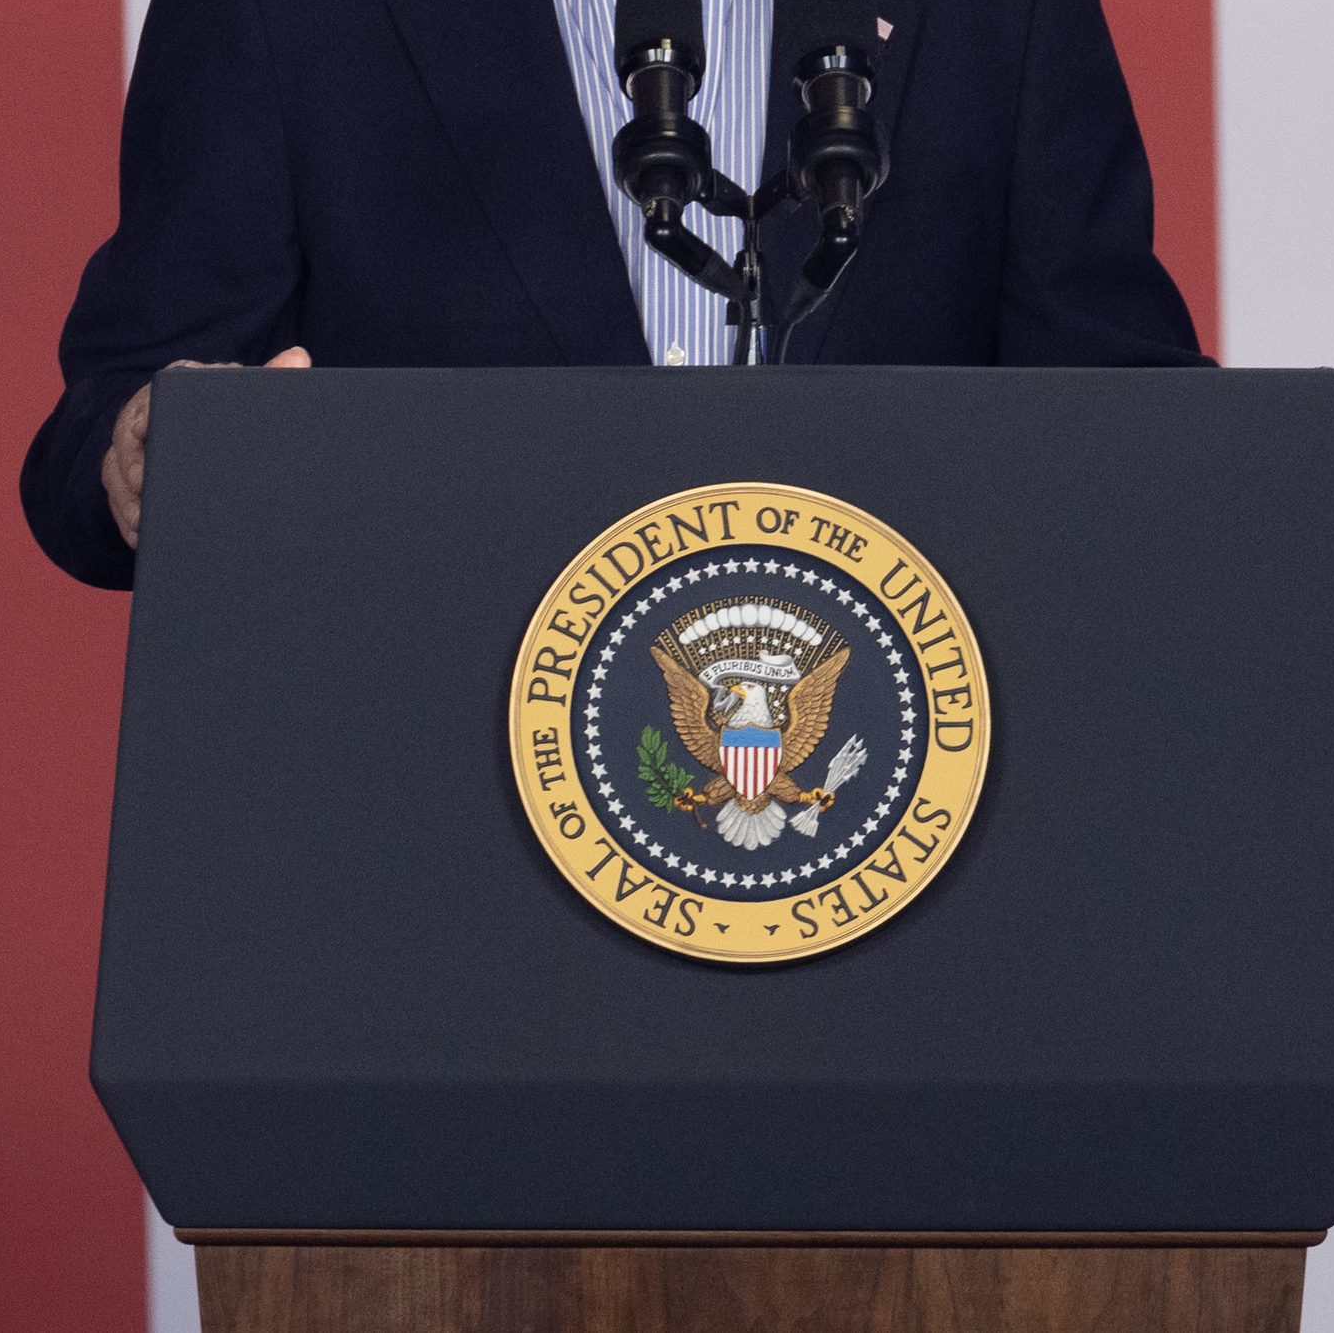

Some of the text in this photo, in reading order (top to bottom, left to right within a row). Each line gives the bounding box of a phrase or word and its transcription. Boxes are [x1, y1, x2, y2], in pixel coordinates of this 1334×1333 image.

[526, 498, 975, 940] SEAL OF THE PRESIDENT OF THE UNITED STATES
[703, 670, 713, 681] E
[711, 661, 762, 676] PLURIBUS
